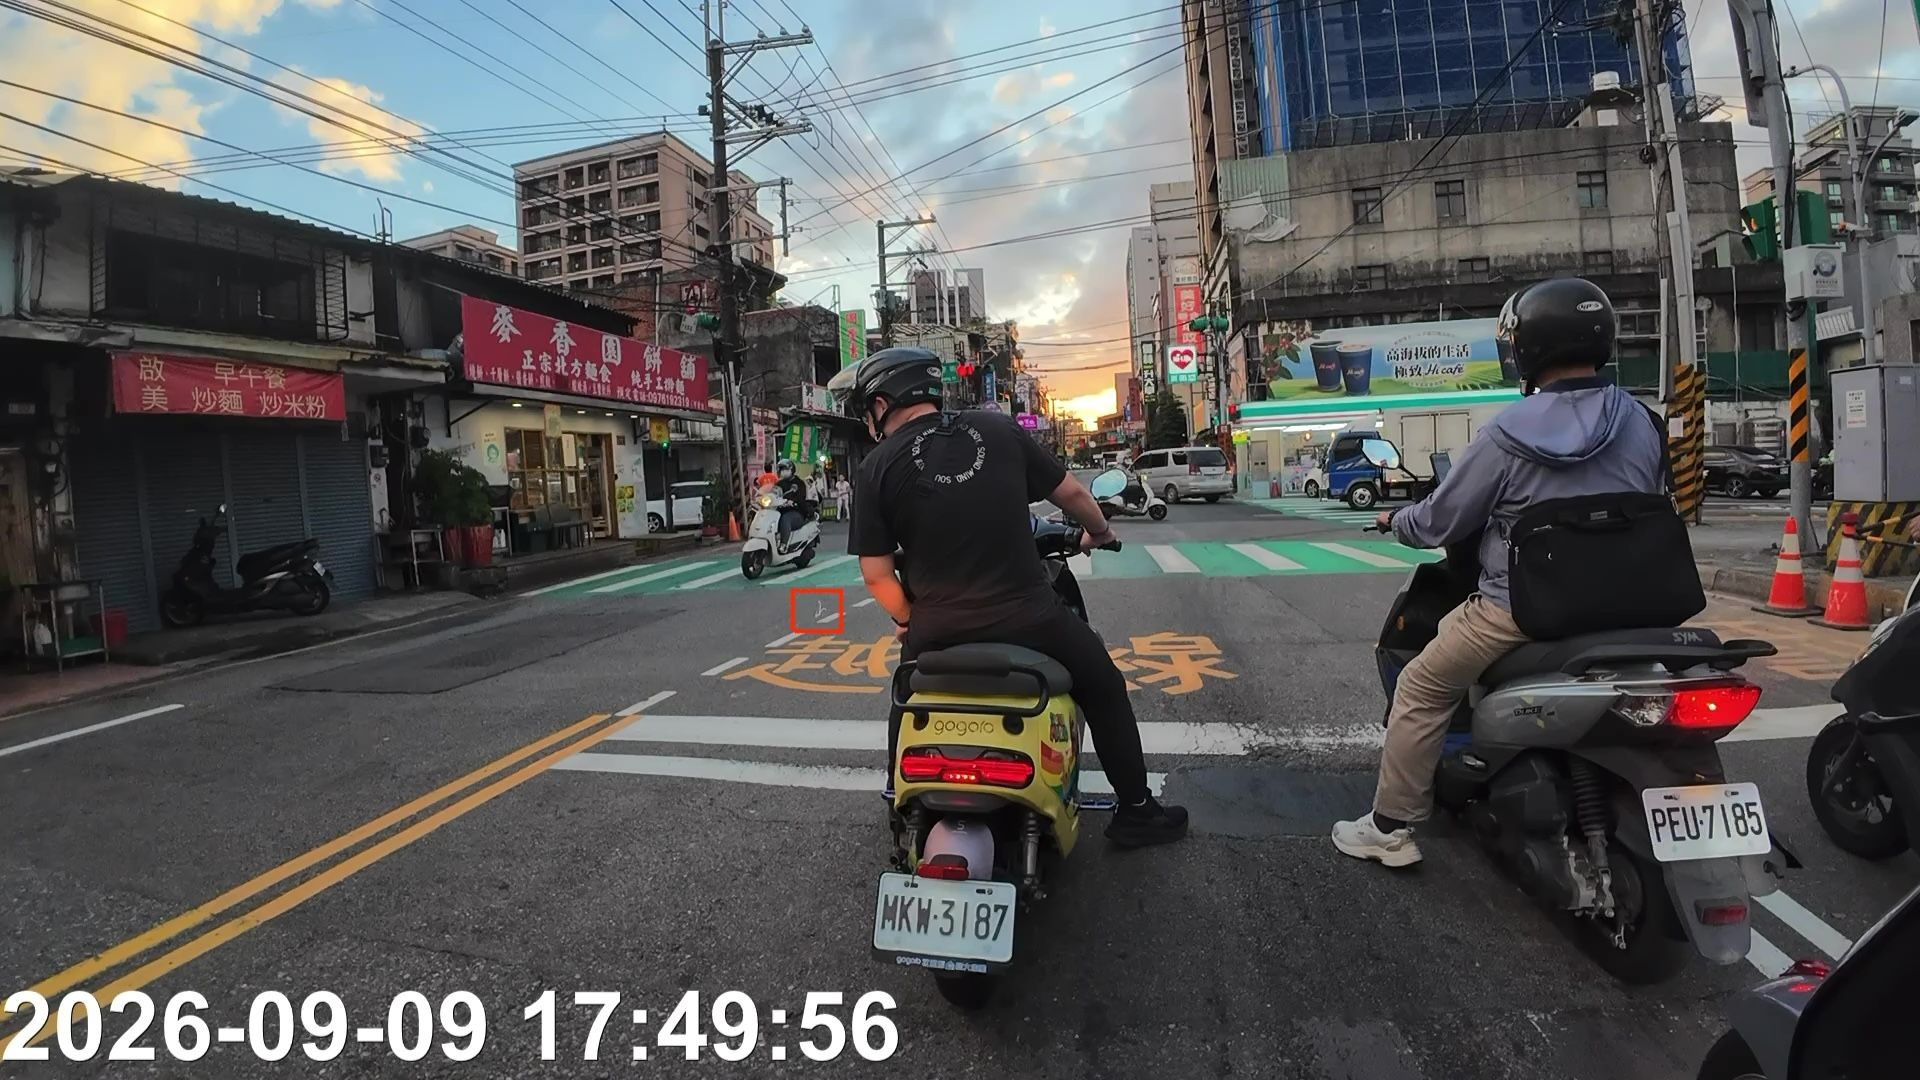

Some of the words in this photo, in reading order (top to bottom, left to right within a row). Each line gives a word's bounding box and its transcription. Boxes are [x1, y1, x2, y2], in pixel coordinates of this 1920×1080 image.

[1386, 343, 1469, 362] 高海拔的生活
[213, 362, 287, 390] 早午餐
[1394, 364, 1422, 379] 極致
[259, 391, 327, 419] 炒米粉
[973, 446, 985, 471] SOUND
[1671, 631, 1704, 645] SYM
[933, 719, 995, 737] gogoro
